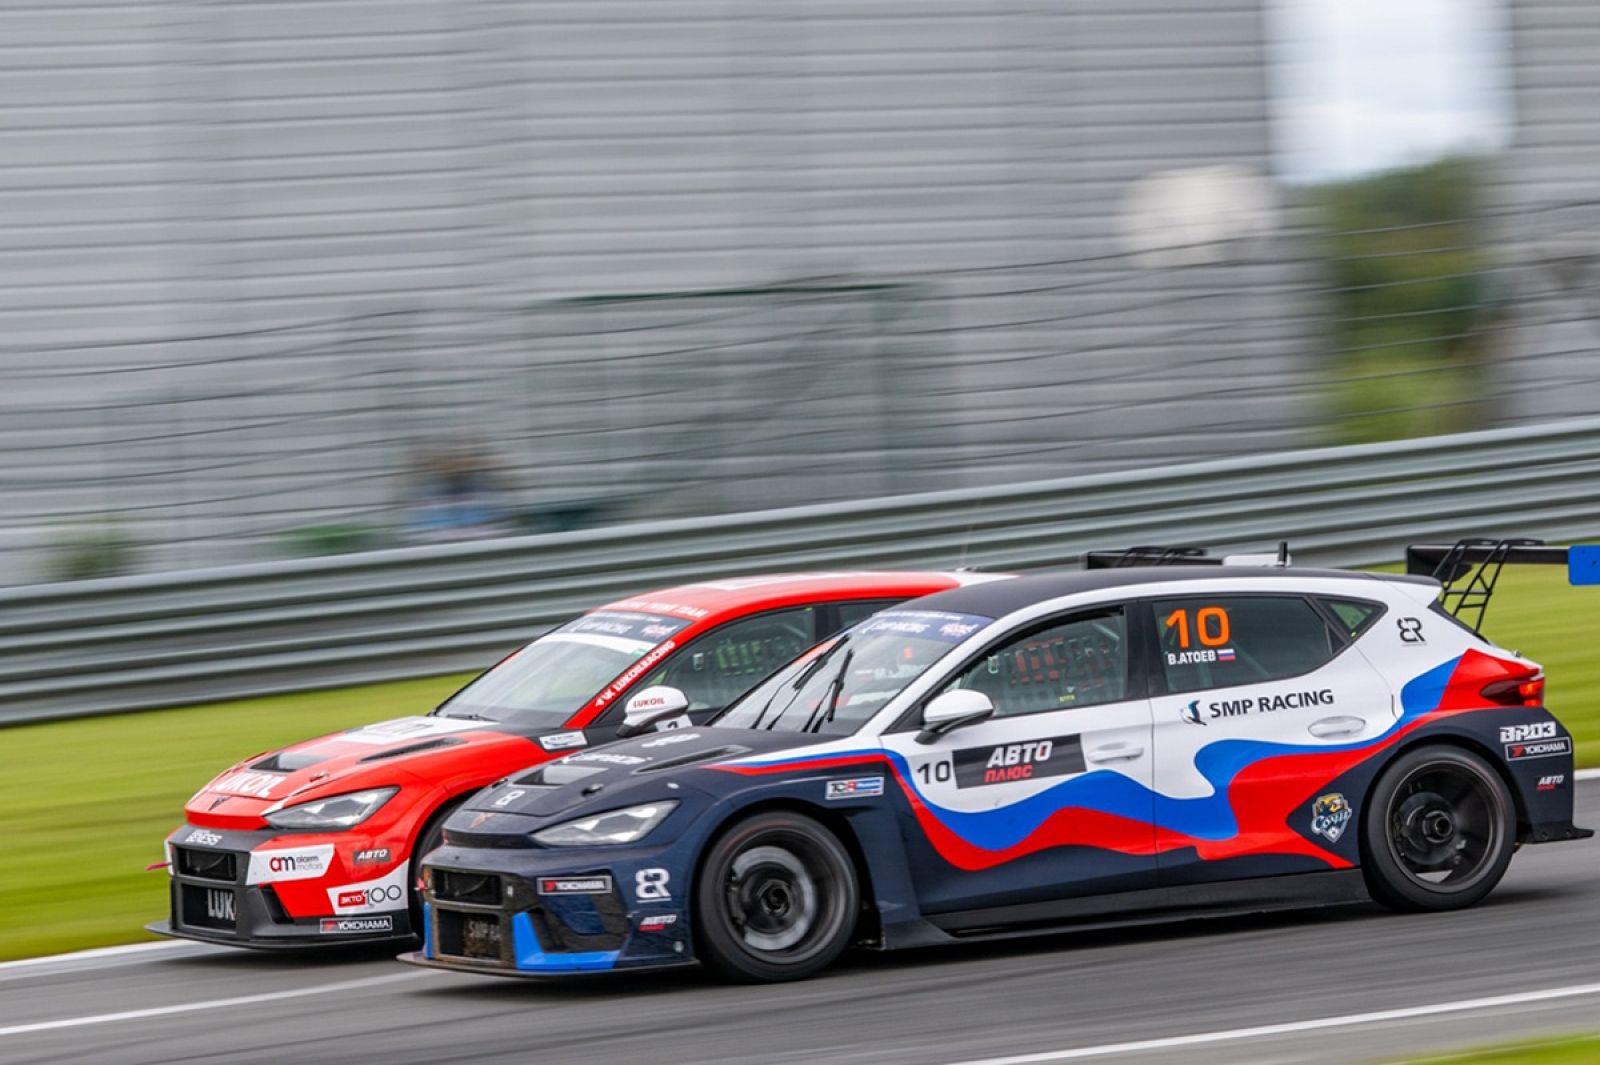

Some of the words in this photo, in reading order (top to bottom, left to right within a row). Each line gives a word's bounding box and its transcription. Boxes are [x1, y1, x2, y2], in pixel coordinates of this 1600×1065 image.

[1166, 606, 1231, 649] 10
[1167, 651, 1216, 665] В.АТОЕВ
[633, 697, 664, 708] LUKOIL
[1209, 699, 1254, 718] SMP
[1258, 689, 1335, 713] RACING
[987, 741, 1053, 768] АВТО
[1524, 742, 1566, 754] YOKOHAMA
[917, 760, 950, 785] 10
[984, 765, 1033, 783] ПЛЮС
[296, 855, 319, 863] alarm
[357, 848, 389, 860] АВТО
[269, 857, 295, 872] am
[207, 889, 237, 920] LUK
[337, 919, 390, 930] YOKOHAMA
